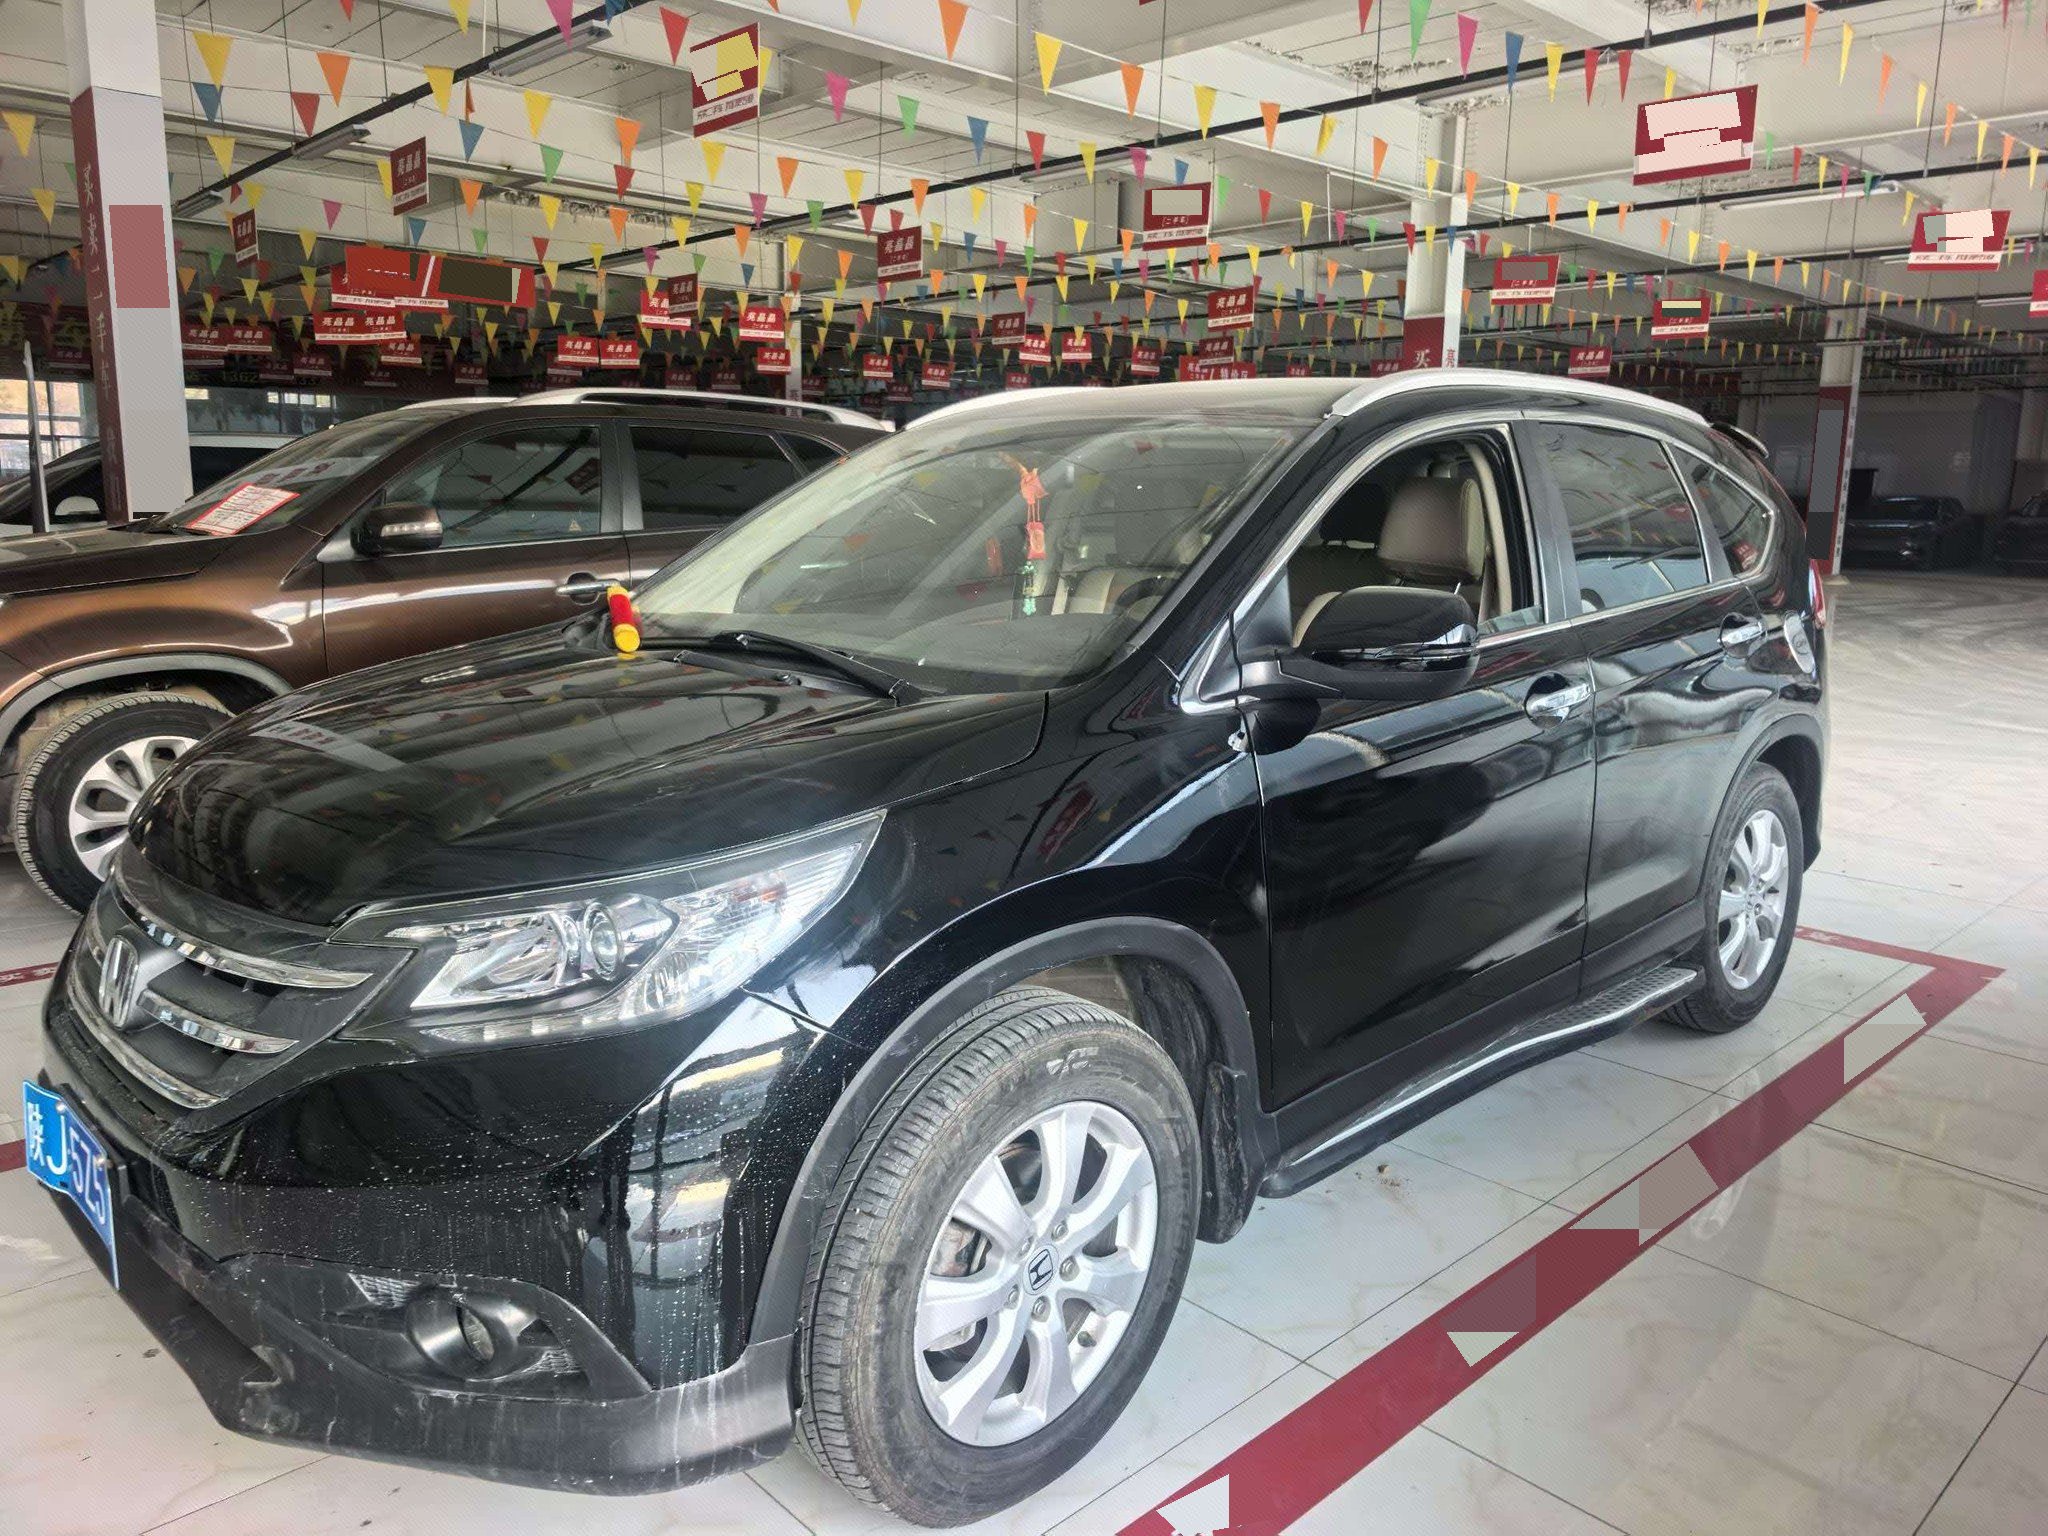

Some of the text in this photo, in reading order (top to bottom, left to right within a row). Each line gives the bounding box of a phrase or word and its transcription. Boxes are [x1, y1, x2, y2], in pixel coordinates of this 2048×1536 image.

[397, 150, 421, 177] 亮晶晶
[1216, 294, 1246, 309] 亮晶晶
[322, 316, 354, 327] 亮晶晶
[365, 315, 396, 326] 亮晶晶
[746, 312, 776, 323] 亮晶晶
[565, 340, 592, 351] 亮晶晶
[607, 344, 633, 354] 亮晶晶
